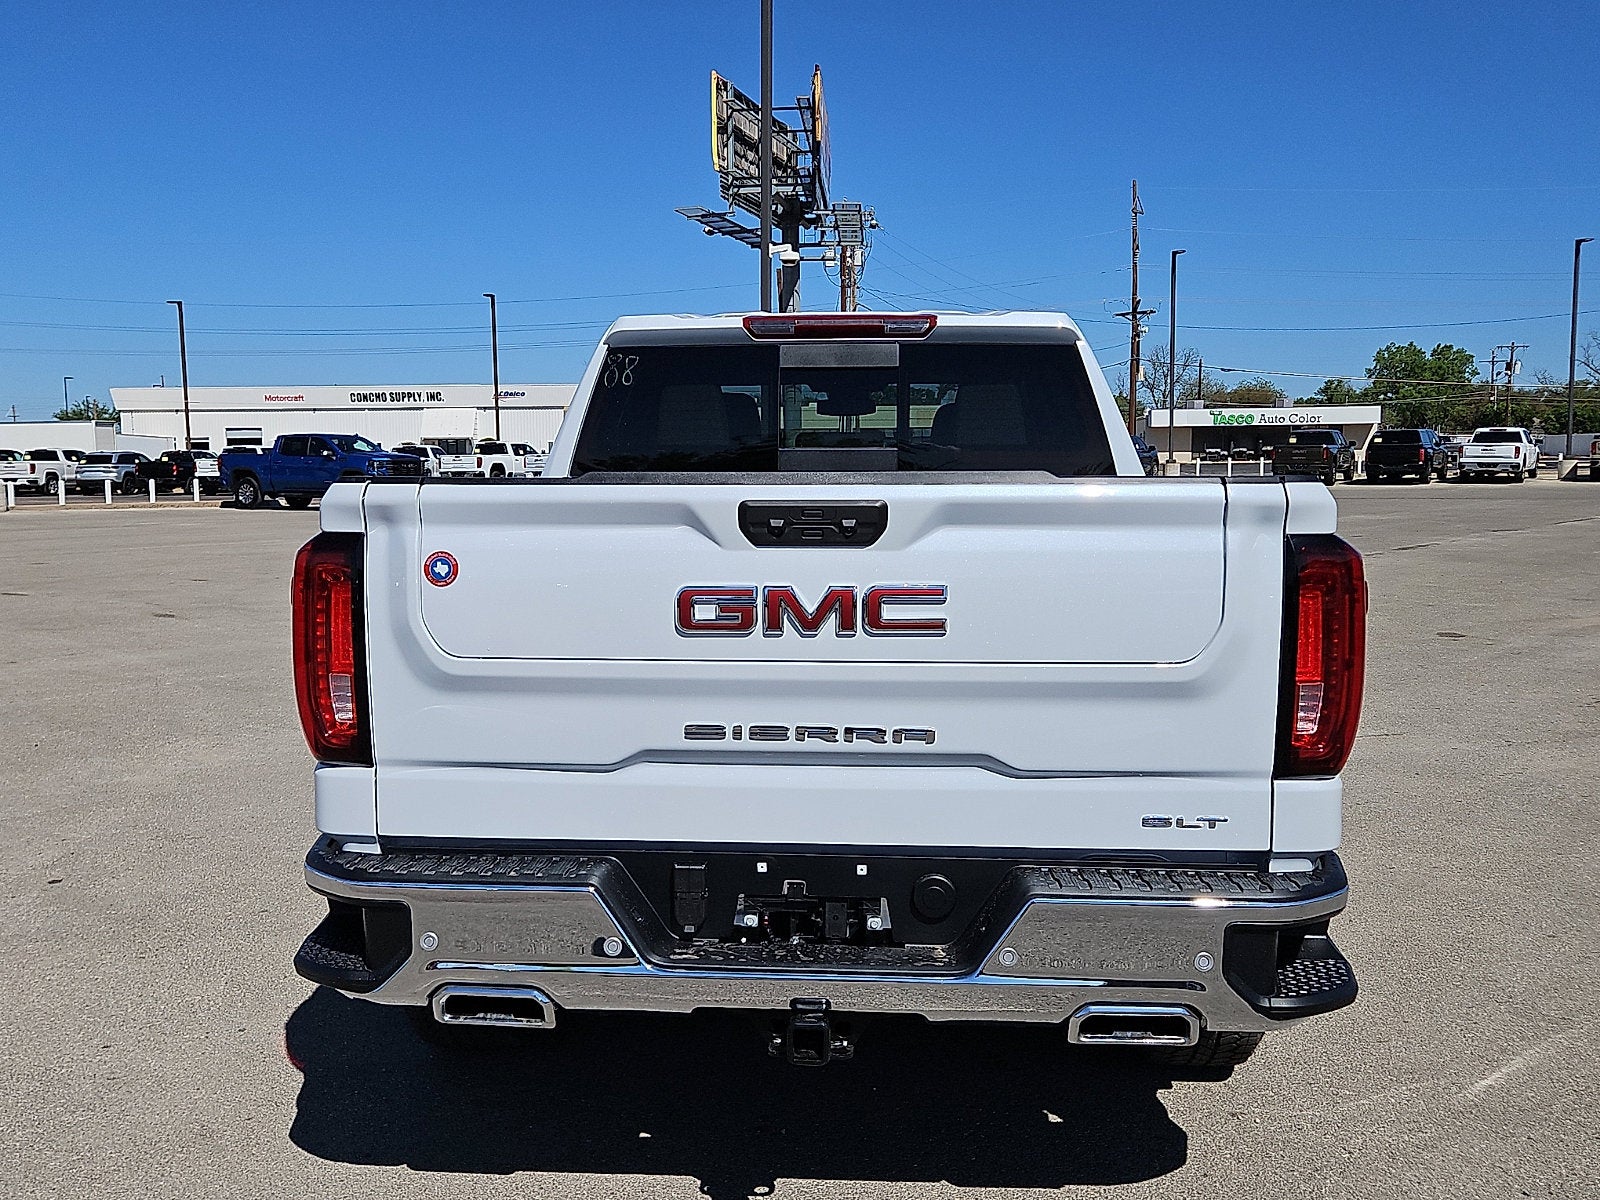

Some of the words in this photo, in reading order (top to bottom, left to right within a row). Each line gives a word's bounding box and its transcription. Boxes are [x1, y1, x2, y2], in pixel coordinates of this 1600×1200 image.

[264, 394, 305, 402] Motorcraft
[349, 391, 388, 403] CONCHO
[388, 391, 425, 403] SUPPLY,
[425, 391, 445, 402] INC.
[1209, 410, 1255, 425] TASCO
[1258, 413, 1286, 424] Auto
[1288, 413, 1323, 424] Color
[674, 585, 948, 638] GMC
[684, 724, 936, 745] SIERRA
[1141, 815, 1229, 829] SLT
